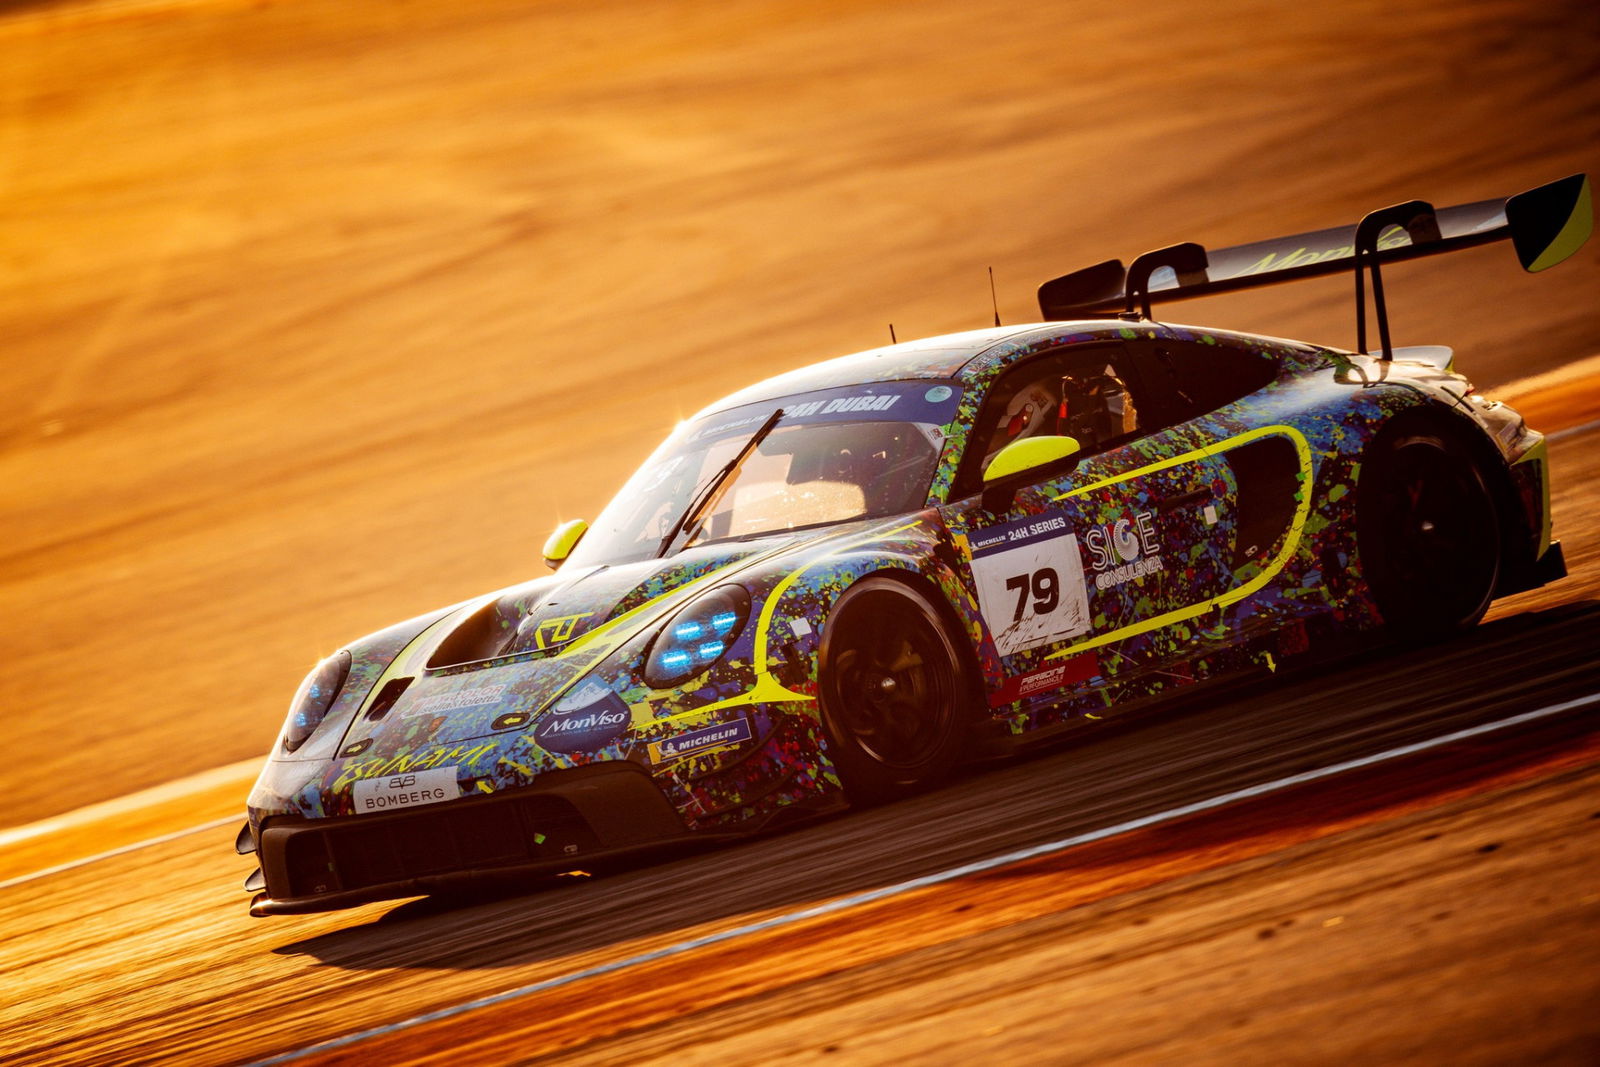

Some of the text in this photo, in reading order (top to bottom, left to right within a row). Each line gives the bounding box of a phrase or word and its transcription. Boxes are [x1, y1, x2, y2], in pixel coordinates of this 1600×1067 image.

[820, 395, 901, 414] DUBAI
[977, 517, 1066, 548] MICHELIN 24H SERIES
[1095, 555, 1164, 590] CONSULENZA
[1006, 567, 1060, 623] 79
[679, 727, 738, 751] MICHELIN
[332, 742, 497, 795] TSUNAMI
[365, 787, 445, 809] BOMBERG
